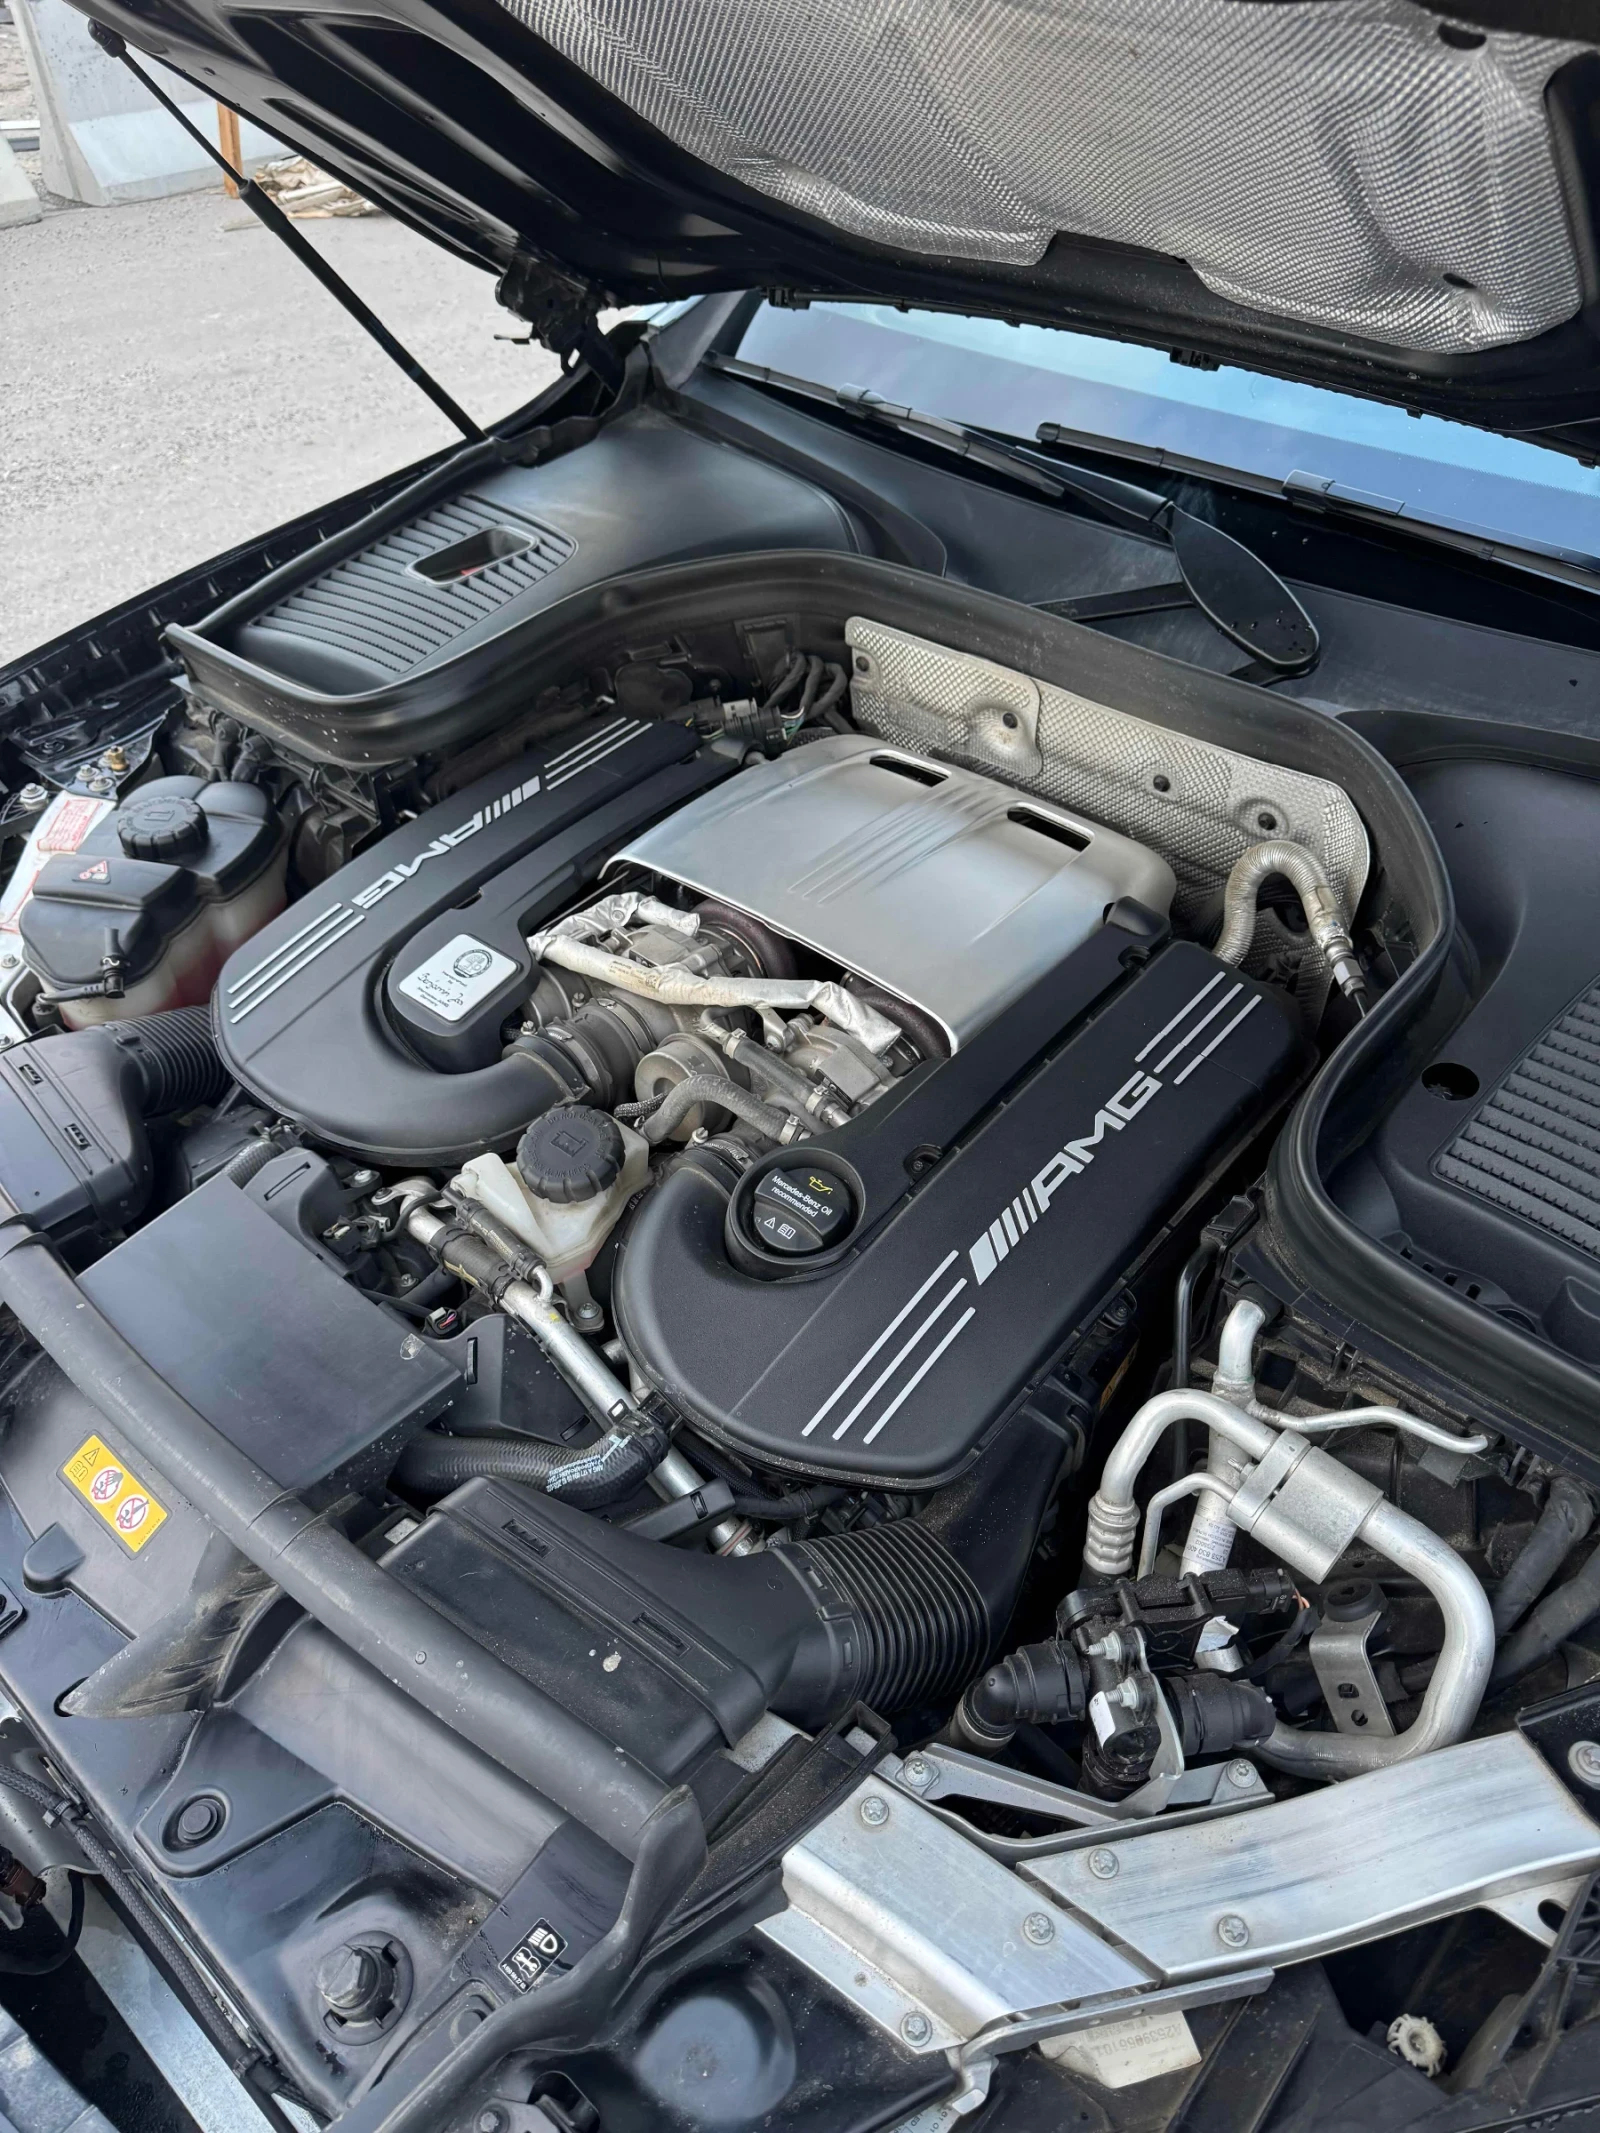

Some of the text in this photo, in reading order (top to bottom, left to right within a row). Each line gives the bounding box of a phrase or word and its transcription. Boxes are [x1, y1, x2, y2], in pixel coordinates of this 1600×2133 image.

[771, 1175, 833, 1216] Mercedes-Benz Oil
[771, 1186, 818, 1218] recommended
